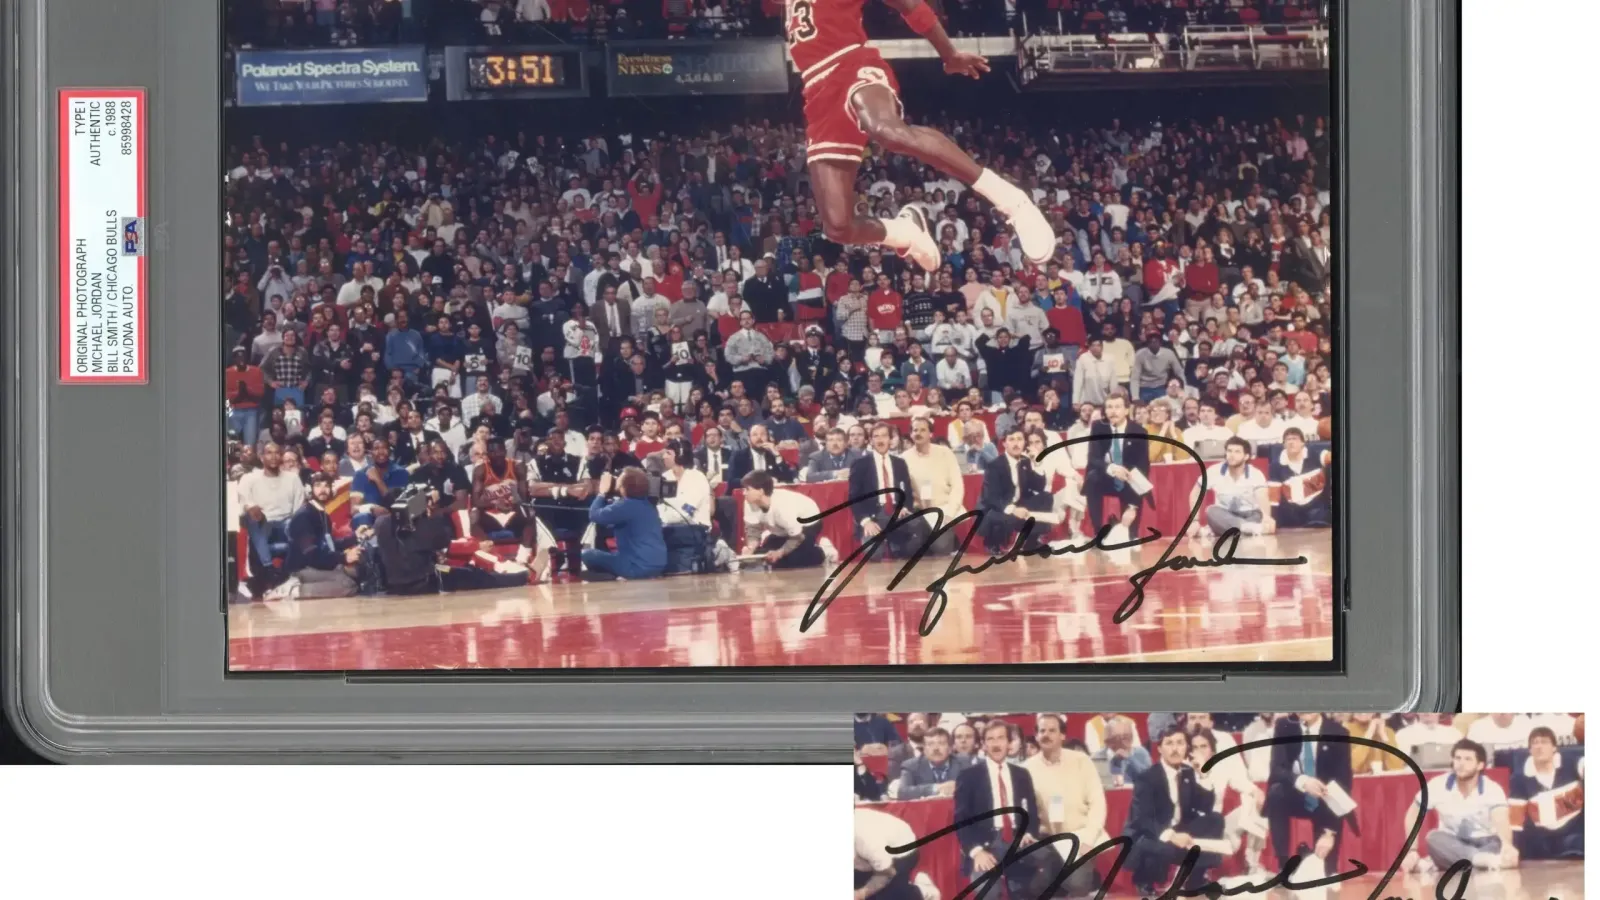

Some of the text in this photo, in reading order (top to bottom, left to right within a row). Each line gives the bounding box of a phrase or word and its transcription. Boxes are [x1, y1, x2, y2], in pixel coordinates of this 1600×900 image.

[242, 62, 301, 78] Polaroid
[303, 60, 361, 78] Spectra
[486, 55, 555, 85] 3:51
[617, 65, 662, 76] NEWS
[75, 107, 86, 136] TYPE
[90, 101, 101, 166] AUTHENTIC
[121, 101, 132, 155] 85998428
[106, 209, 117, 245] BULLS
[124, 220, 138, 253] PSA
[106, 248, 117, 301] CHICAGO
[76, 238, 88, 373] ORIGINAL PHOTOGRAPH
[91, 272, 103, 373] MICHAEL JORDAN
[107, 310, 118, 347] SMITH
[107, 350, 119, 373] BILL
[123, 321, 134, 373] PSA/DNA
